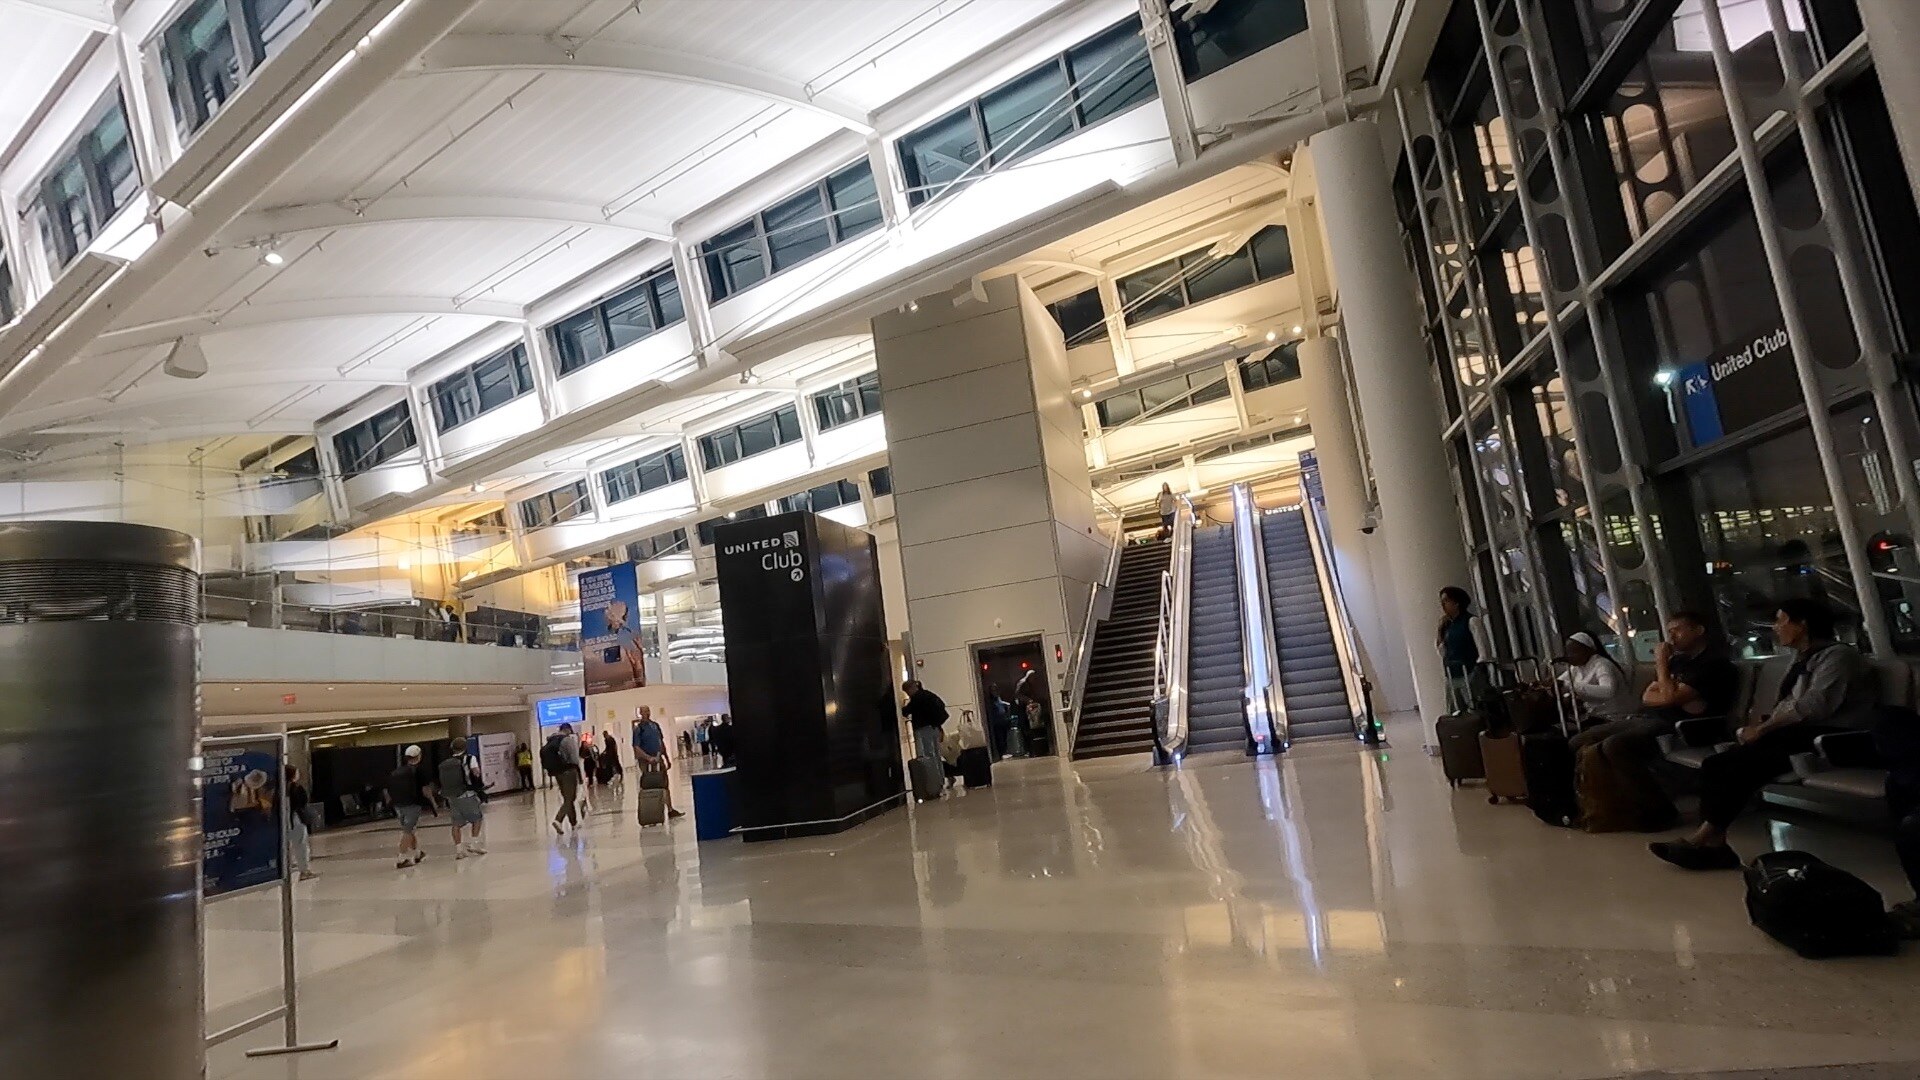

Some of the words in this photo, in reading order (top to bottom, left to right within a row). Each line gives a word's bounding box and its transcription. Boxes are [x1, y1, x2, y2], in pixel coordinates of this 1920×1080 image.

[1710, 345, 1753, 381] United
[1753, 328, 1788, 358] Club
[724, 538, 781, 555] UNITED
[762, 549, 803, 571] Club
[206, 827, 241, 841] SHOULD
